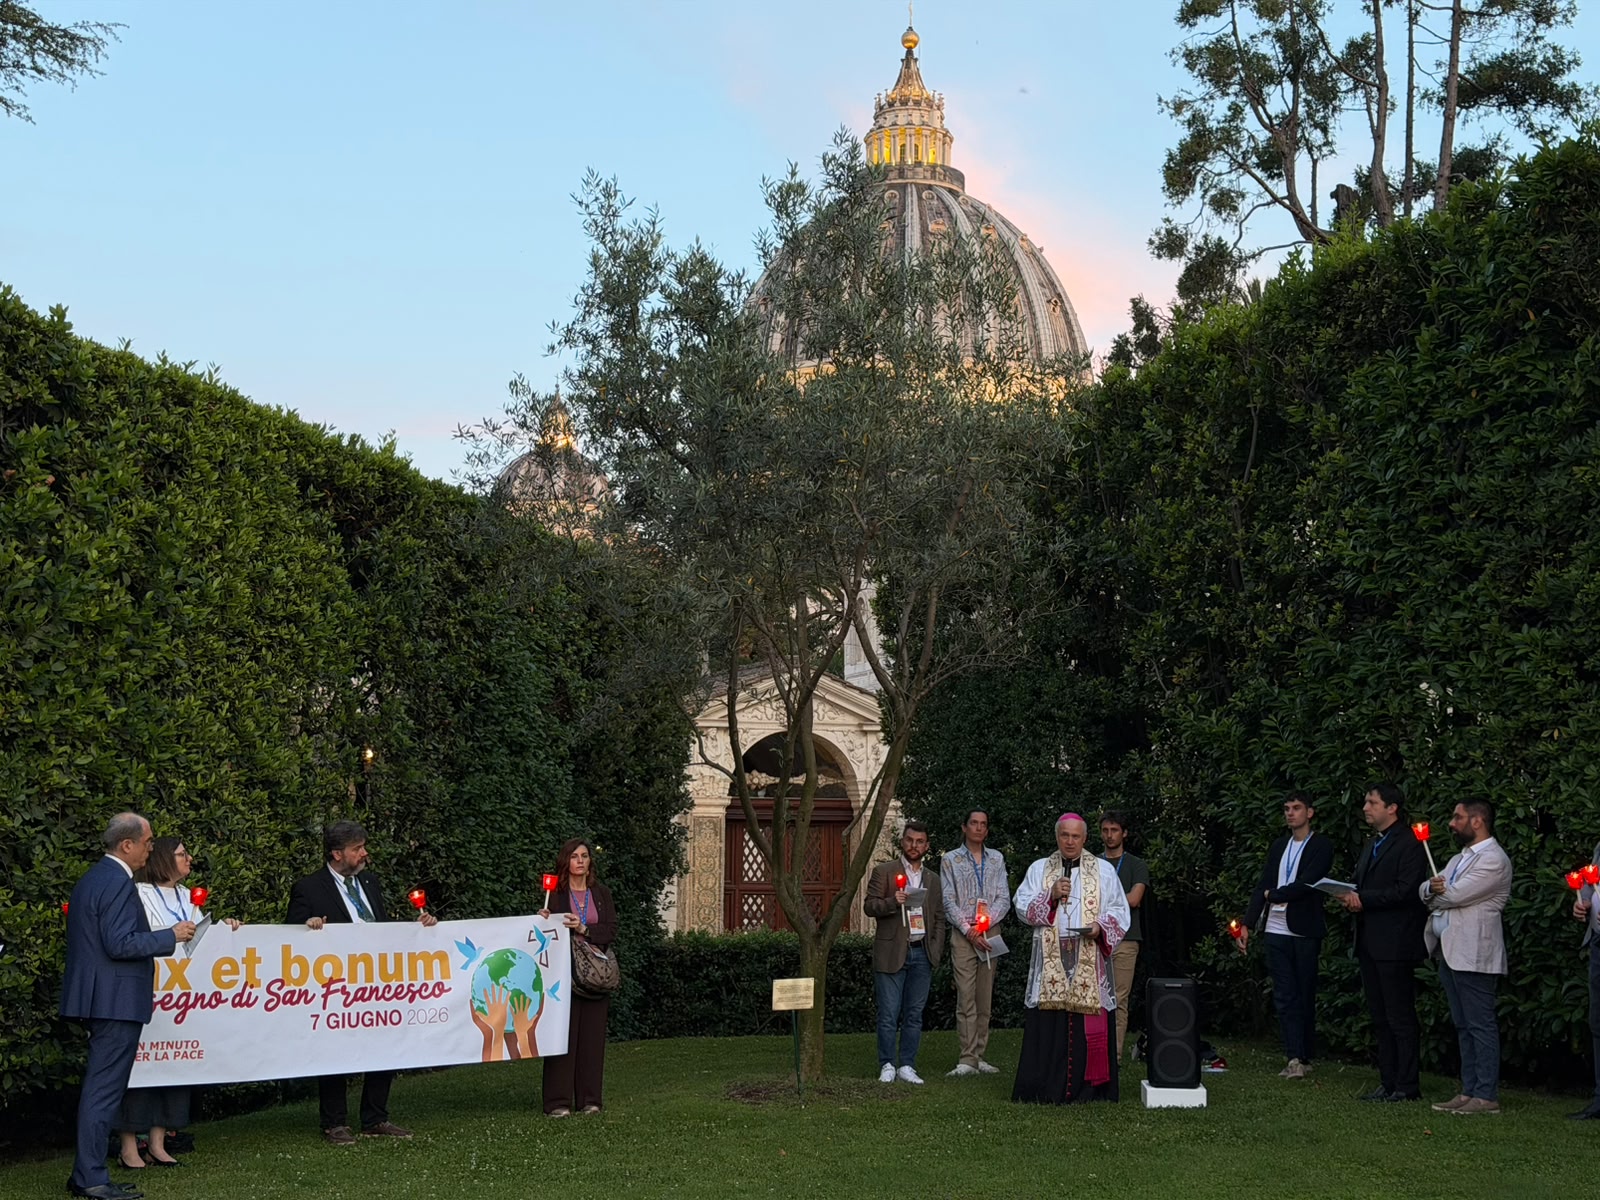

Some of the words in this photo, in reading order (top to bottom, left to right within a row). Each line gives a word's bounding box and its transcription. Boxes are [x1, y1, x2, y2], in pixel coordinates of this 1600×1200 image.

[211, 947, 262, 990] et
[281, 944, 451, 987] bonum
[231, 980, 259, 1009] di
[263, 978, 317, 1012] San
[321, 976, 452, 1011] Francesco
[310, 1014, 321, 1031] 7
[326, 1009, 402, 1030] GIUGNO
[407, 1007, 449, 1026] 2026
[135, 1052, 151, 1062] ER
[154, 1051, 169, 1061] LA
[173, 1050, 204, 1060] PACE
[138, 1041, 146, 1051] N
[150, 1040, 200, 1051] MINUTO
